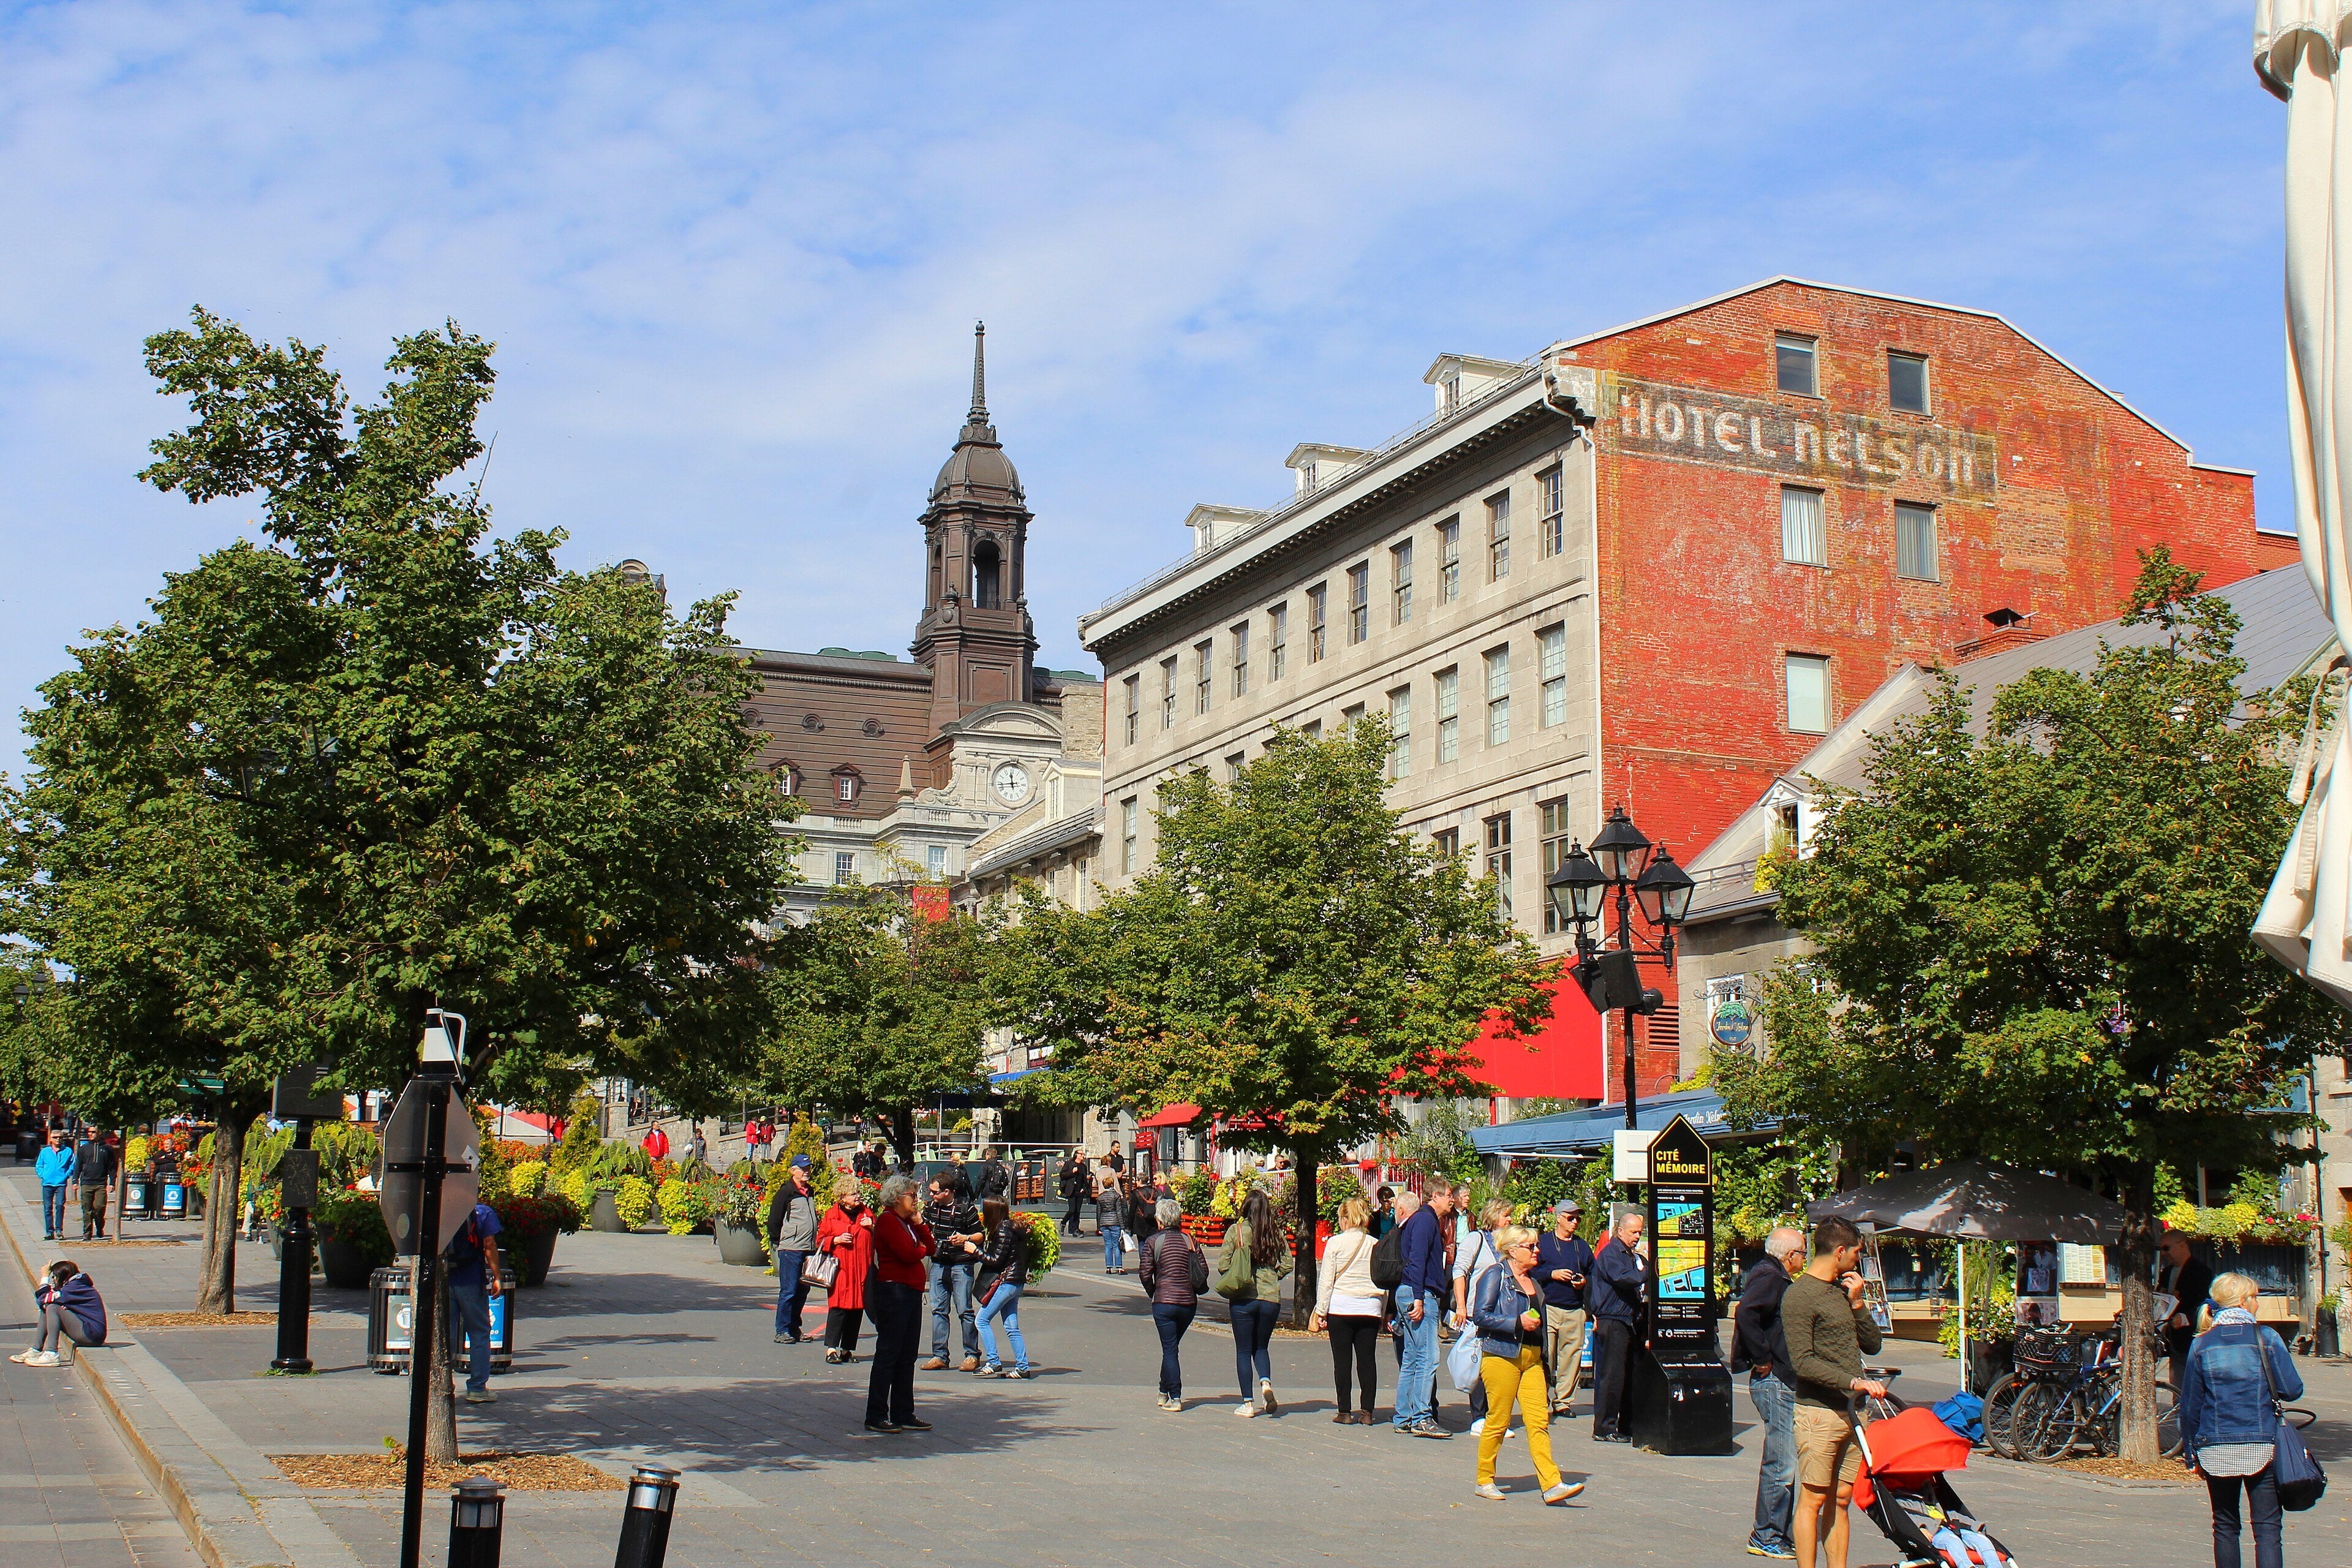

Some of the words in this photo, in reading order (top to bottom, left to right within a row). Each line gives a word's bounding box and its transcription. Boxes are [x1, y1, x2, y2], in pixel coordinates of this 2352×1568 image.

[1621, 394, 1777, 458] HOTEL
[1656, 1148, 1679, 1161] CITÉ
[1656, 1161, 1706, 1174] MÉMOIRE
